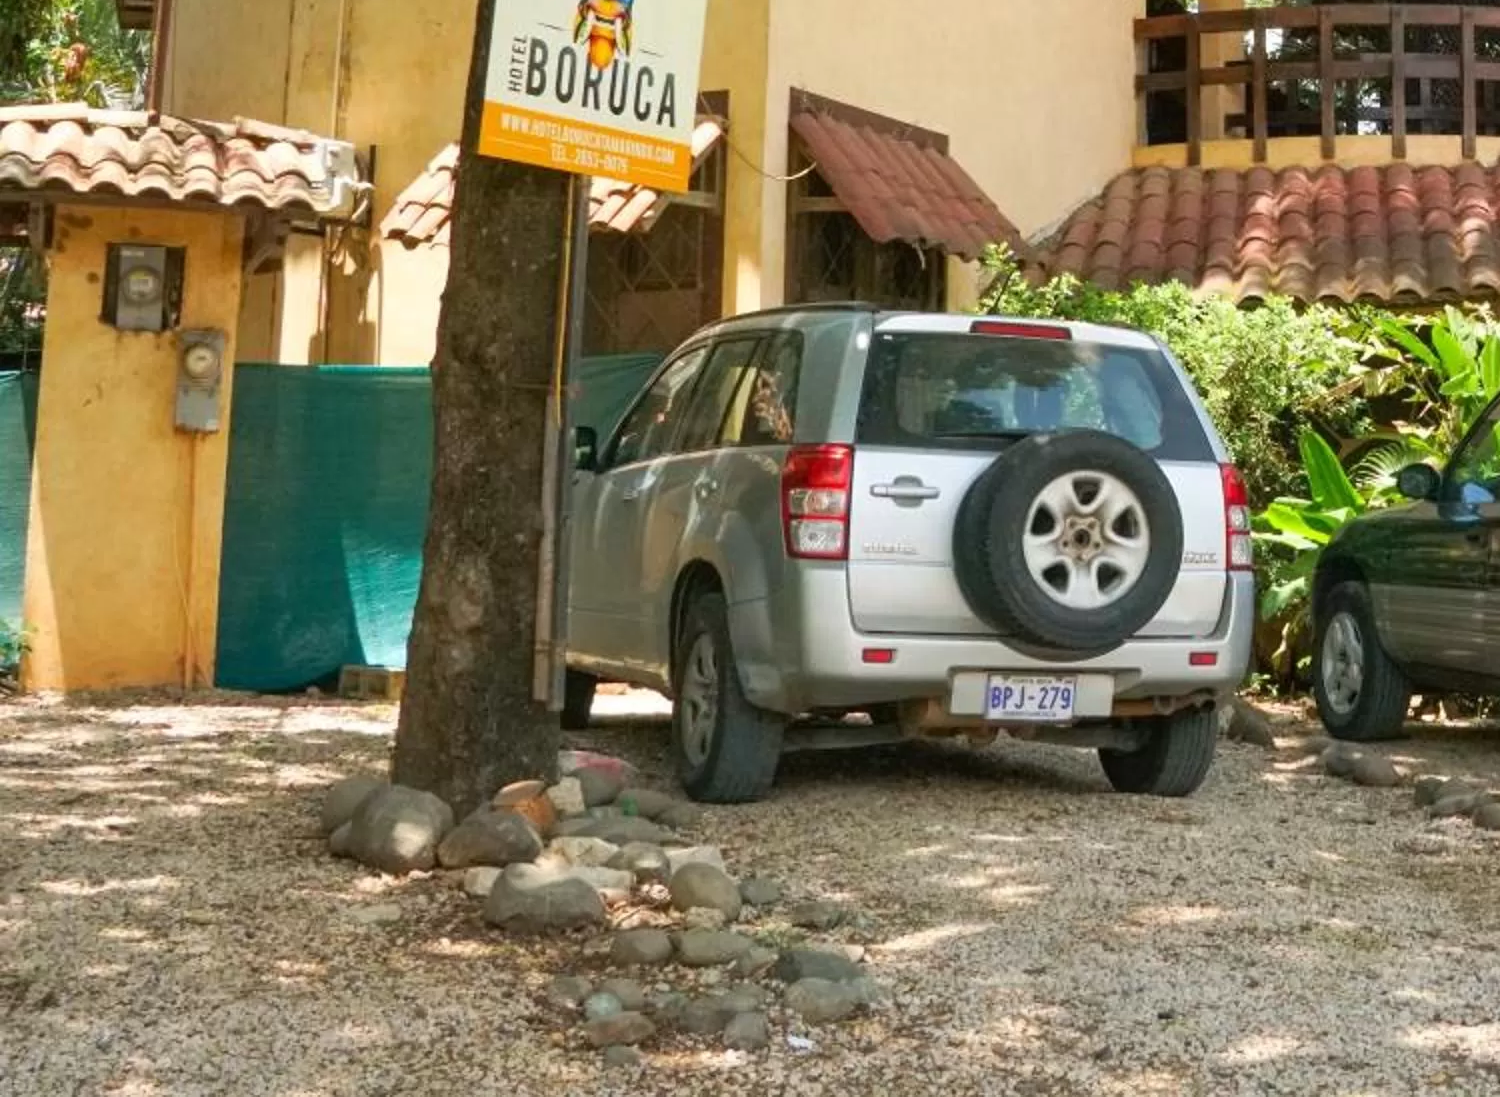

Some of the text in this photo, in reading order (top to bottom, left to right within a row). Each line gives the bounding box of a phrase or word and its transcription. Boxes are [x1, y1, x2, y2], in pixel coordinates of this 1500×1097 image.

[507, 34, 528, 93] HOTEL
[526, 38, 676, 128] BORUCA
[991, 685, 1071, 710] BPJ-279
